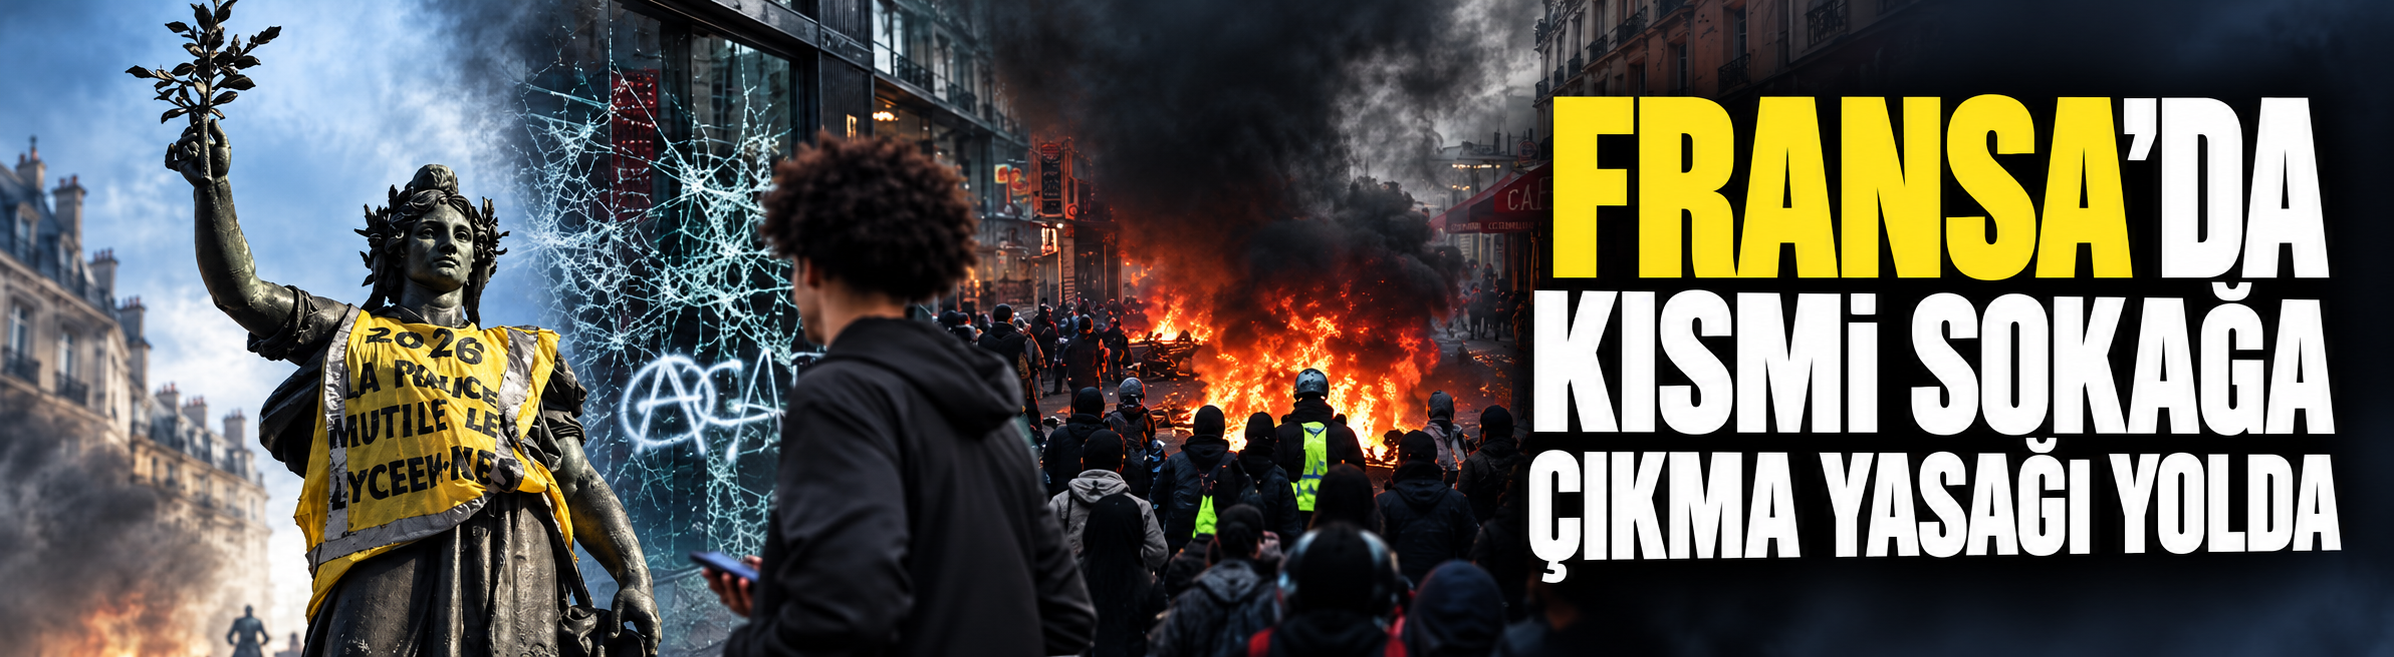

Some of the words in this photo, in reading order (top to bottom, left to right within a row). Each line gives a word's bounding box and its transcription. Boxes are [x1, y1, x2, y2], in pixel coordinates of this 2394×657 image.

[1508, 176, 1553, 211] CAF
[365, 326, 485, 366] 2026
[346, 361, 381, 400] LA
[329, 398, 449, 450] MUTILE
